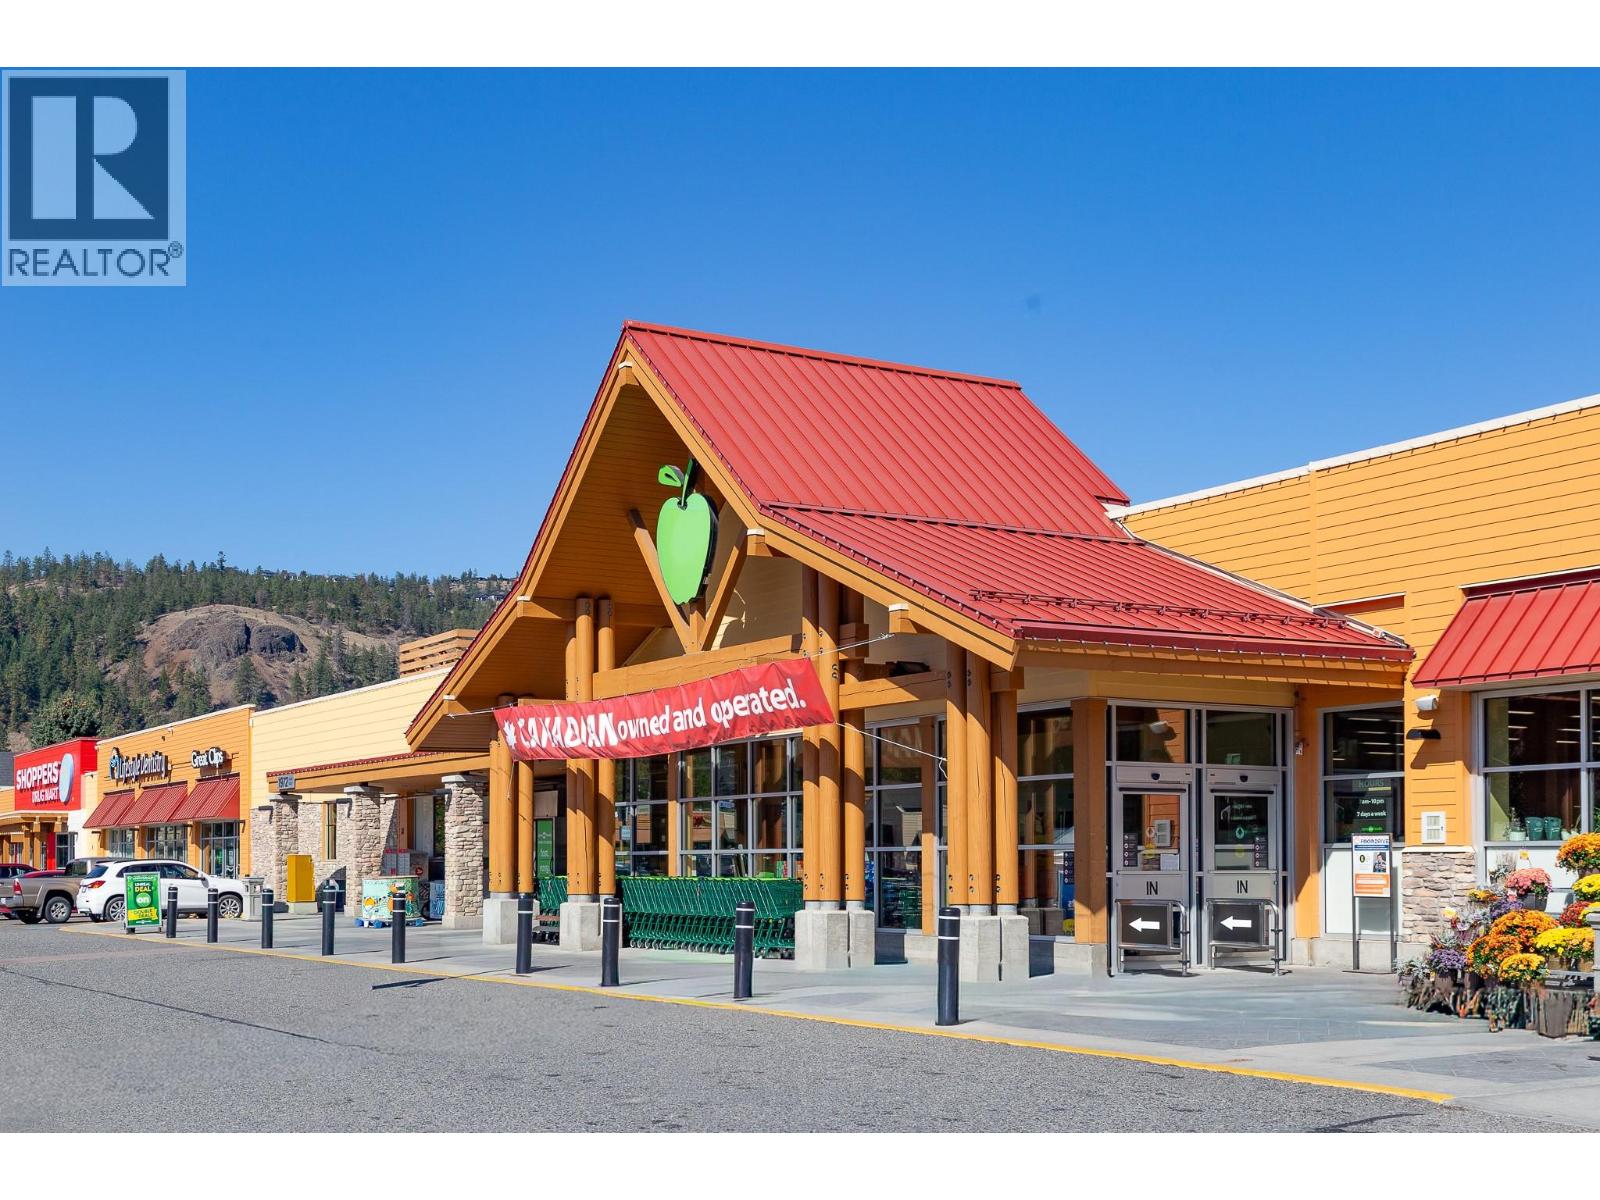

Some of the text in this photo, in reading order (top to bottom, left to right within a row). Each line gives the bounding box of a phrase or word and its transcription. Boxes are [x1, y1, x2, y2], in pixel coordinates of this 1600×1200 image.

[519, 679, 806, 748] CANADIAN owned and operated.
[191, 750, 208, 768] Great
[16, 760, 59, 790] SHOPPERS
[1146, 880, 1159, 896] IN
[1236, 879, 1249, 894] IN
